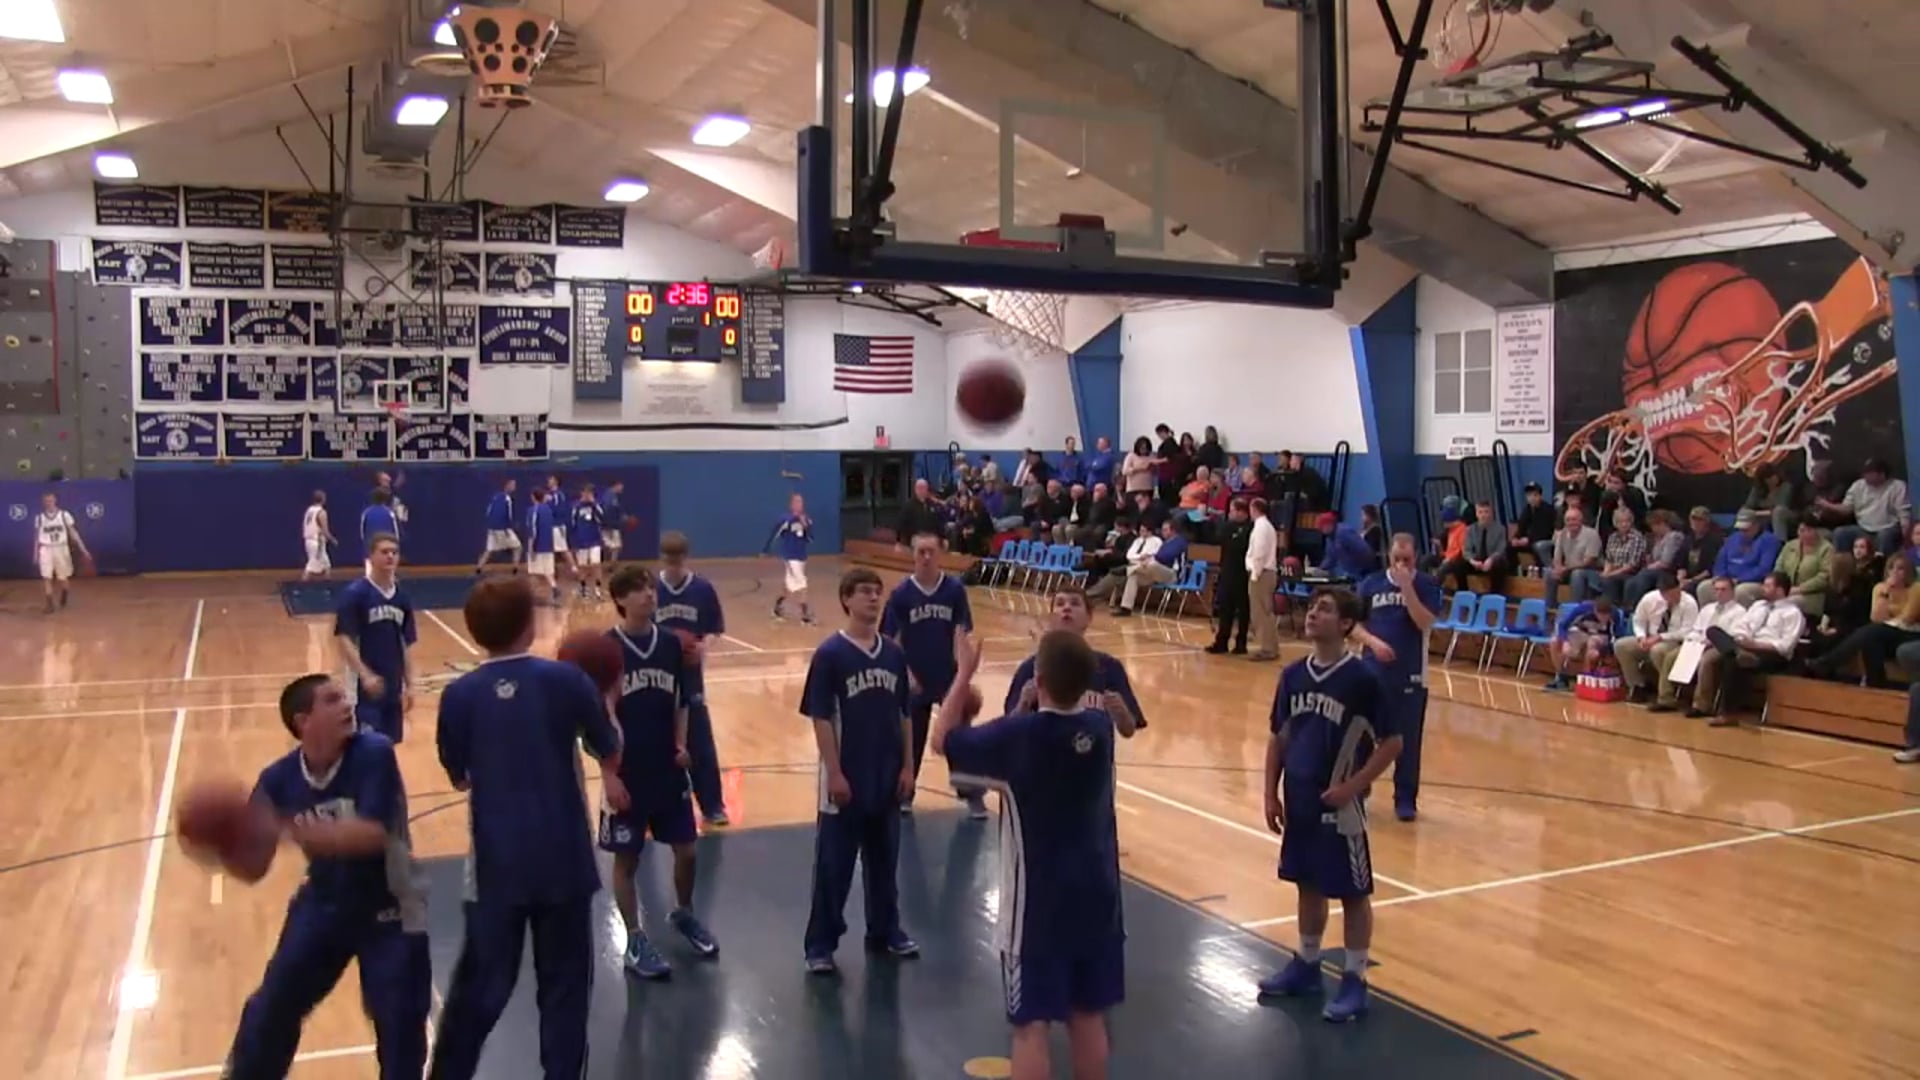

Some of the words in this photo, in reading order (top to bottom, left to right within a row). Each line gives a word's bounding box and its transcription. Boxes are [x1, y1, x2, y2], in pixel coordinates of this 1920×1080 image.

[627, 293, 654, 315] 00
[668, 284, 708, 306] 2:36
[715, 296, 740, 318] 00
[671, 316, 695, 326] period
[481, 320, 540, 345] SPORTSMANSHIP
[544, 326, 567, 345] AWARD
[631, 325, 642, 343] 0
[724, 328, 735, 346] 0
[515, 351, 556, 361] BASKETBALL
[1372, 591, 1407, 609] EAST
[368, 604, 405, 625] EASTON
[655, 603, 698, 624] EASTON
[909, 603, 954, 625] EASTON
[622, 667, 676, 697] EASTON
[846, 667, 899, 699] EASTON
[1290, 692, 1347, 726] EASTON
